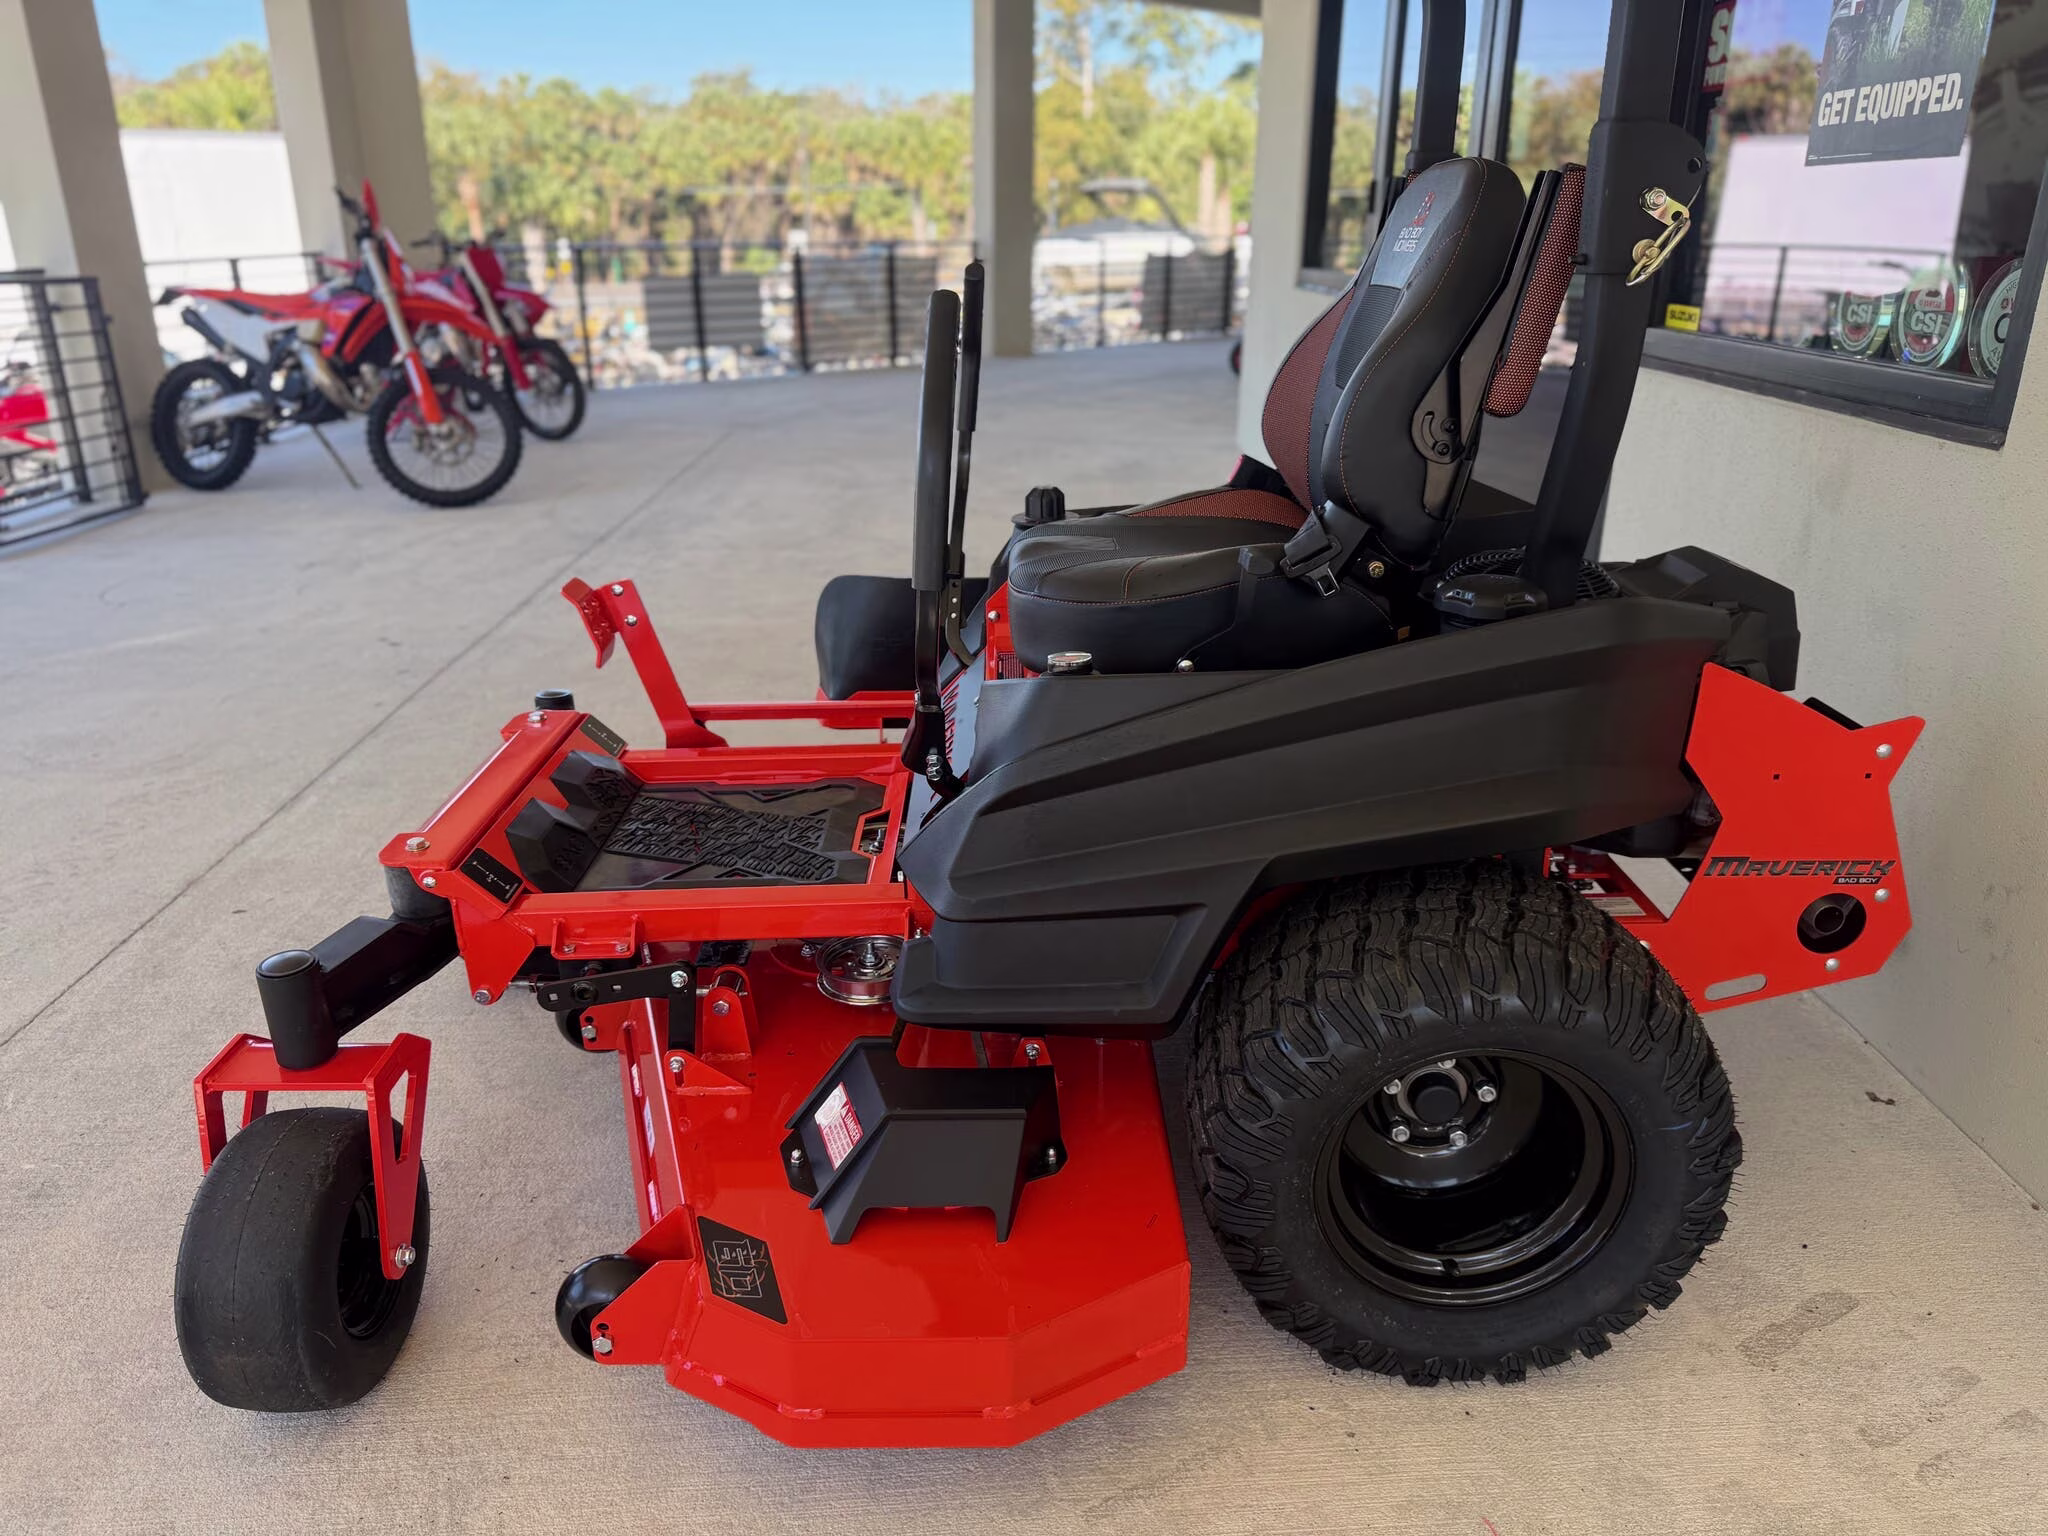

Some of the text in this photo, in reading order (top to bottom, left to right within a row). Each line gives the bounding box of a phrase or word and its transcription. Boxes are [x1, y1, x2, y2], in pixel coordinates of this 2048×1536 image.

[1818, 72, 1964, 127] GET EQUIPPED.
[1846, 303, 1873, 323] CSI
[1910, 310, 1943, 334] CSI
[1703, 856, 1896, 876] MAVERICK
